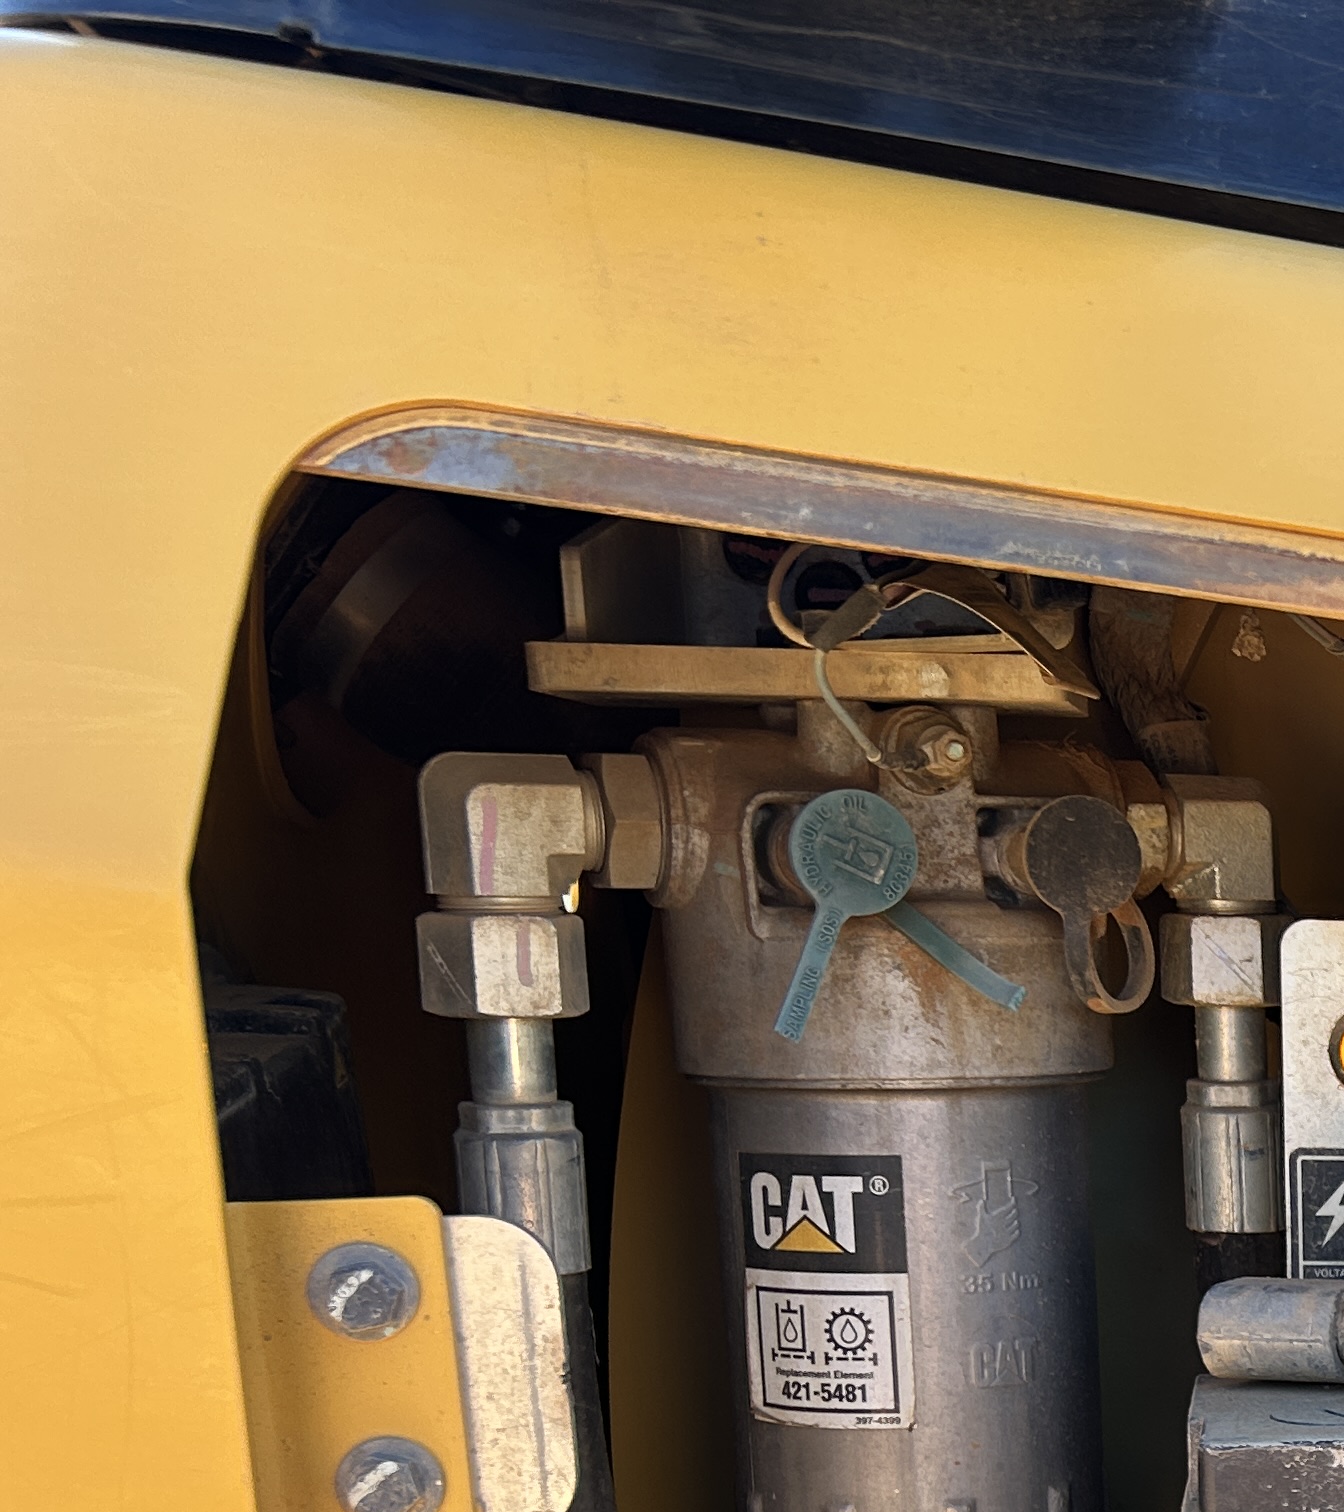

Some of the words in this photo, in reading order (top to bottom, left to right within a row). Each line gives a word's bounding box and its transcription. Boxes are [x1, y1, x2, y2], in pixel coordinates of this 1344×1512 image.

[801, 804, 833, 897] HYDRAULIC
[843, 796, 868, 812] OIL
[783, 967, 820, 1040] SAMPLING
[750, 1171, 864, 1254] CAT
[782, 1380, 867, 1402] 421-5481
[968, 1338, 1039, 1388] CAT
